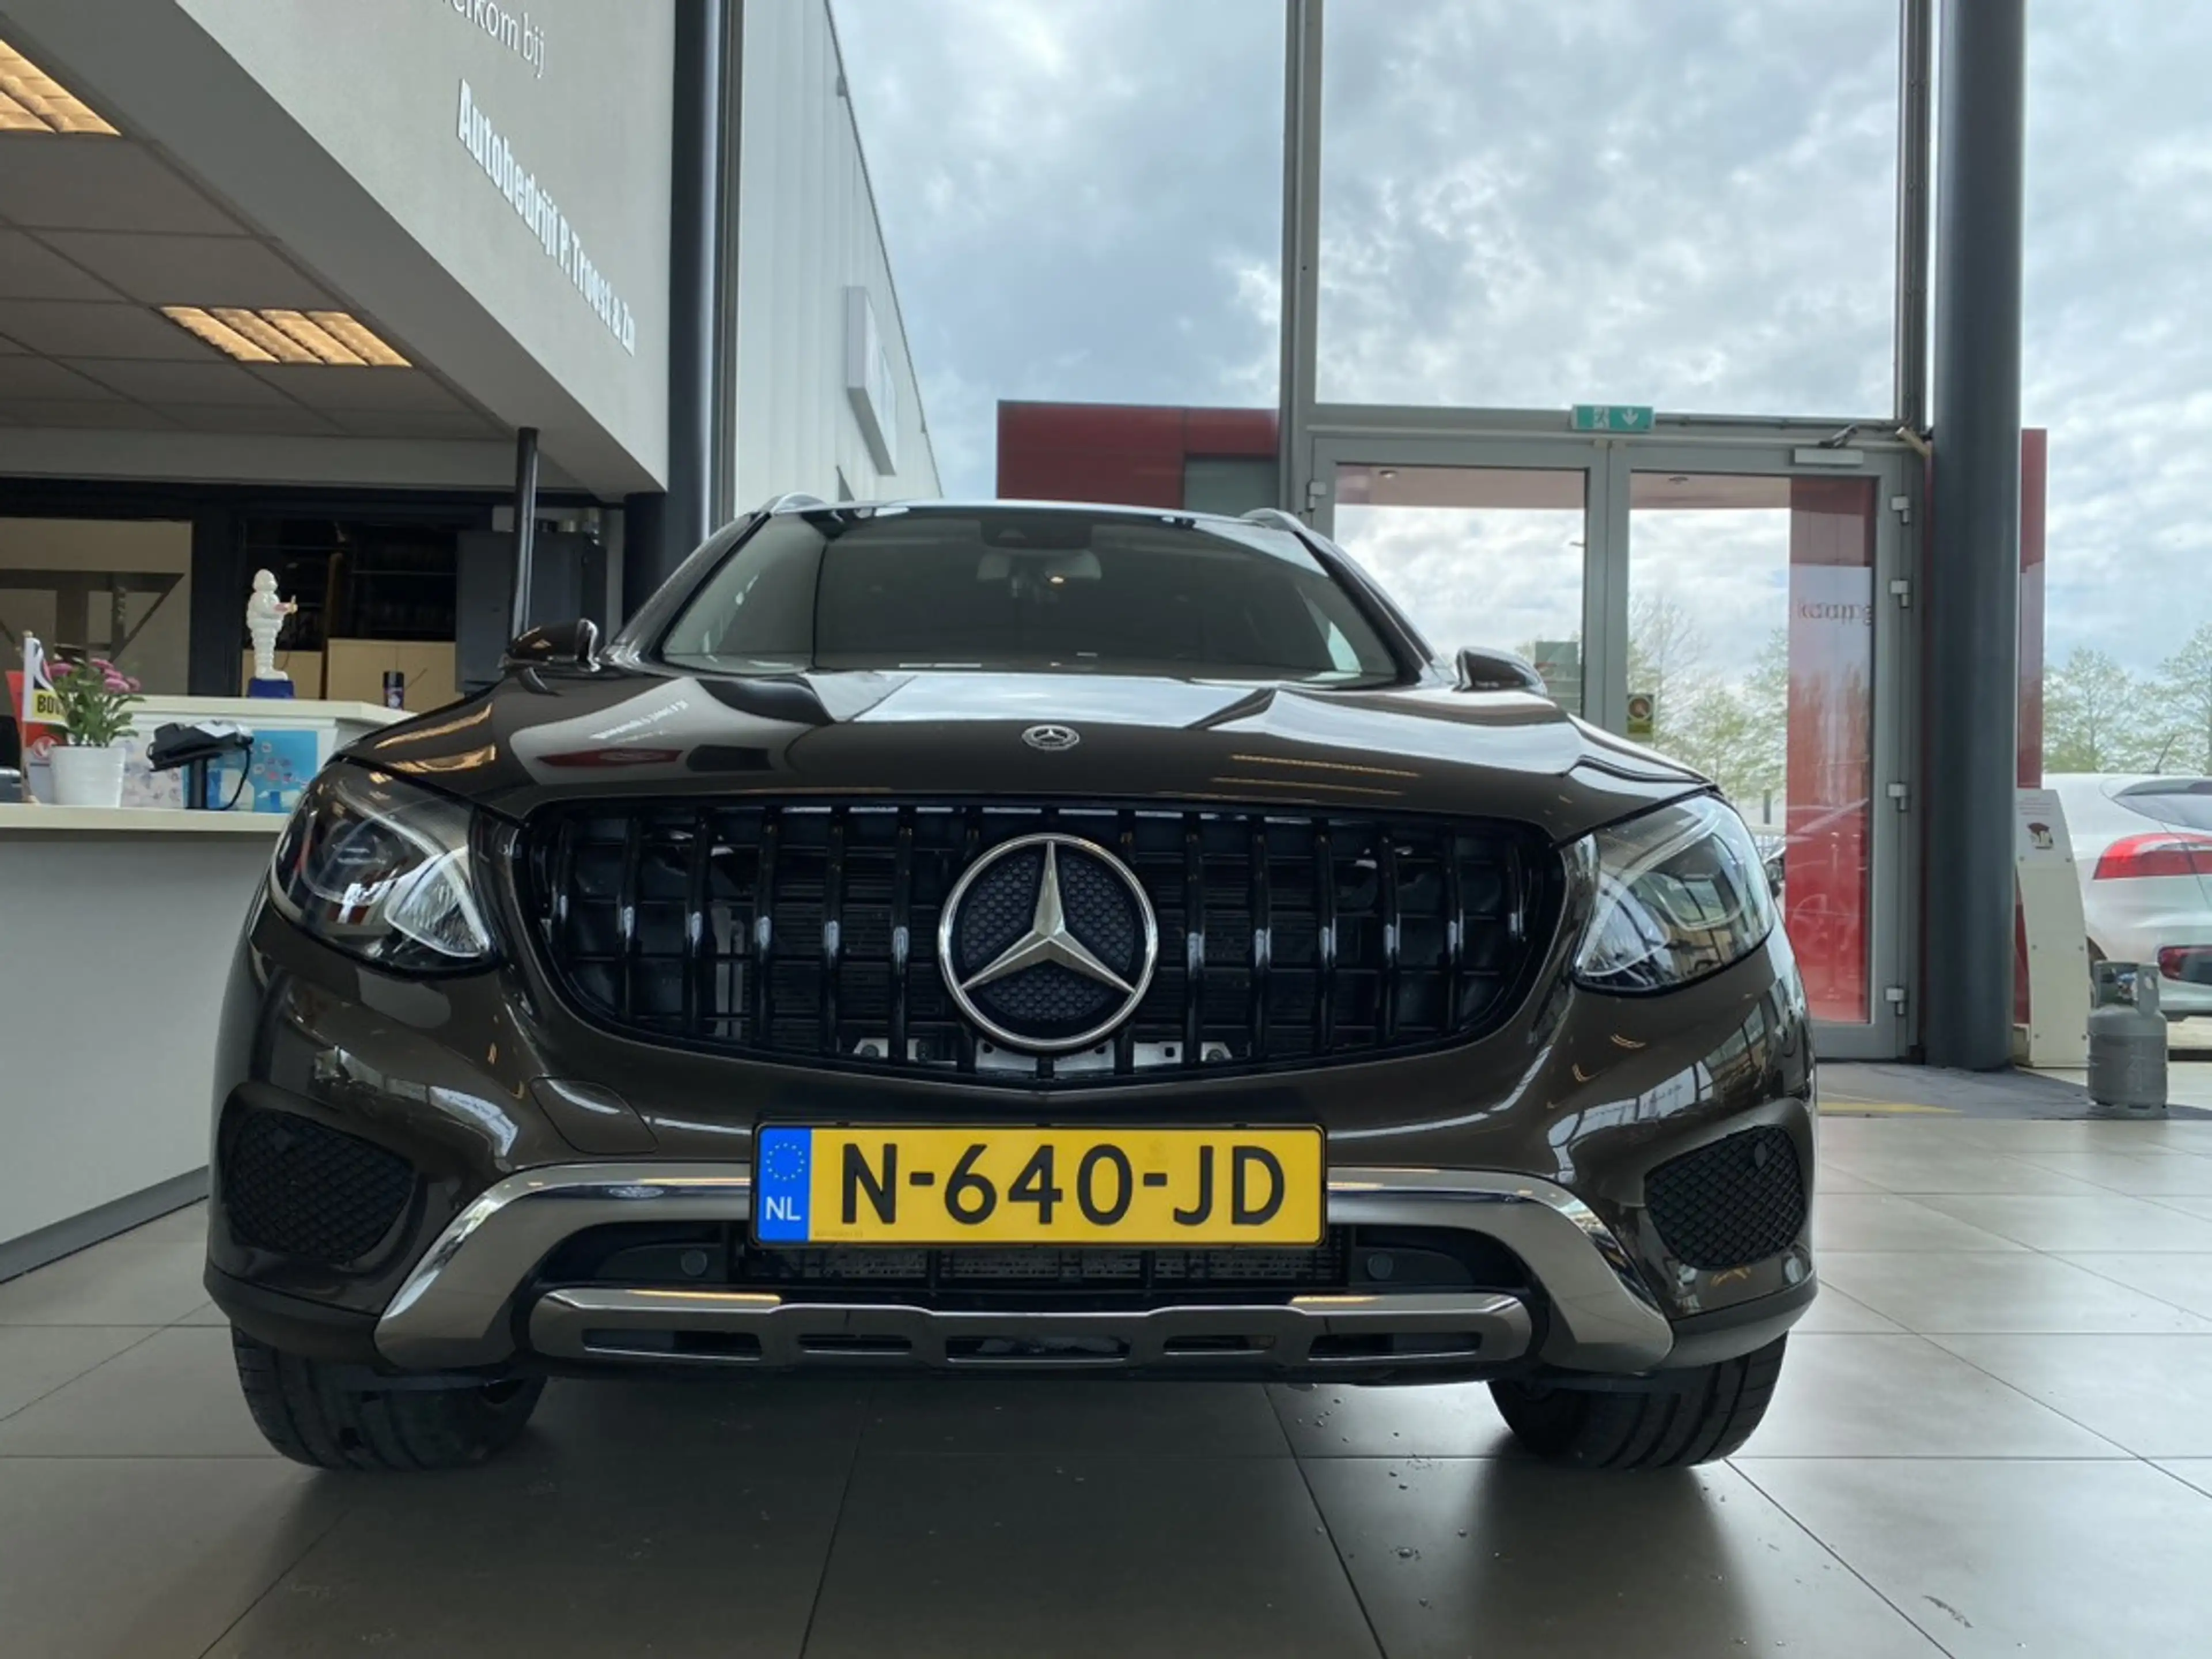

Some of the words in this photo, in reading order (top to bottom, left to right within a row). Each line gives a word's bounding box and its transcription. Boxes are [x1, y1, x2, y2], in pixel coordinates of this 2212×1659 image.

[522, 12, 544, 79] bij
[458, 78, 558, 257] Autobedrijf
[766, 1196, 802, 1221] NL
[840, 1143, 1285, 1226] N-640-JD
